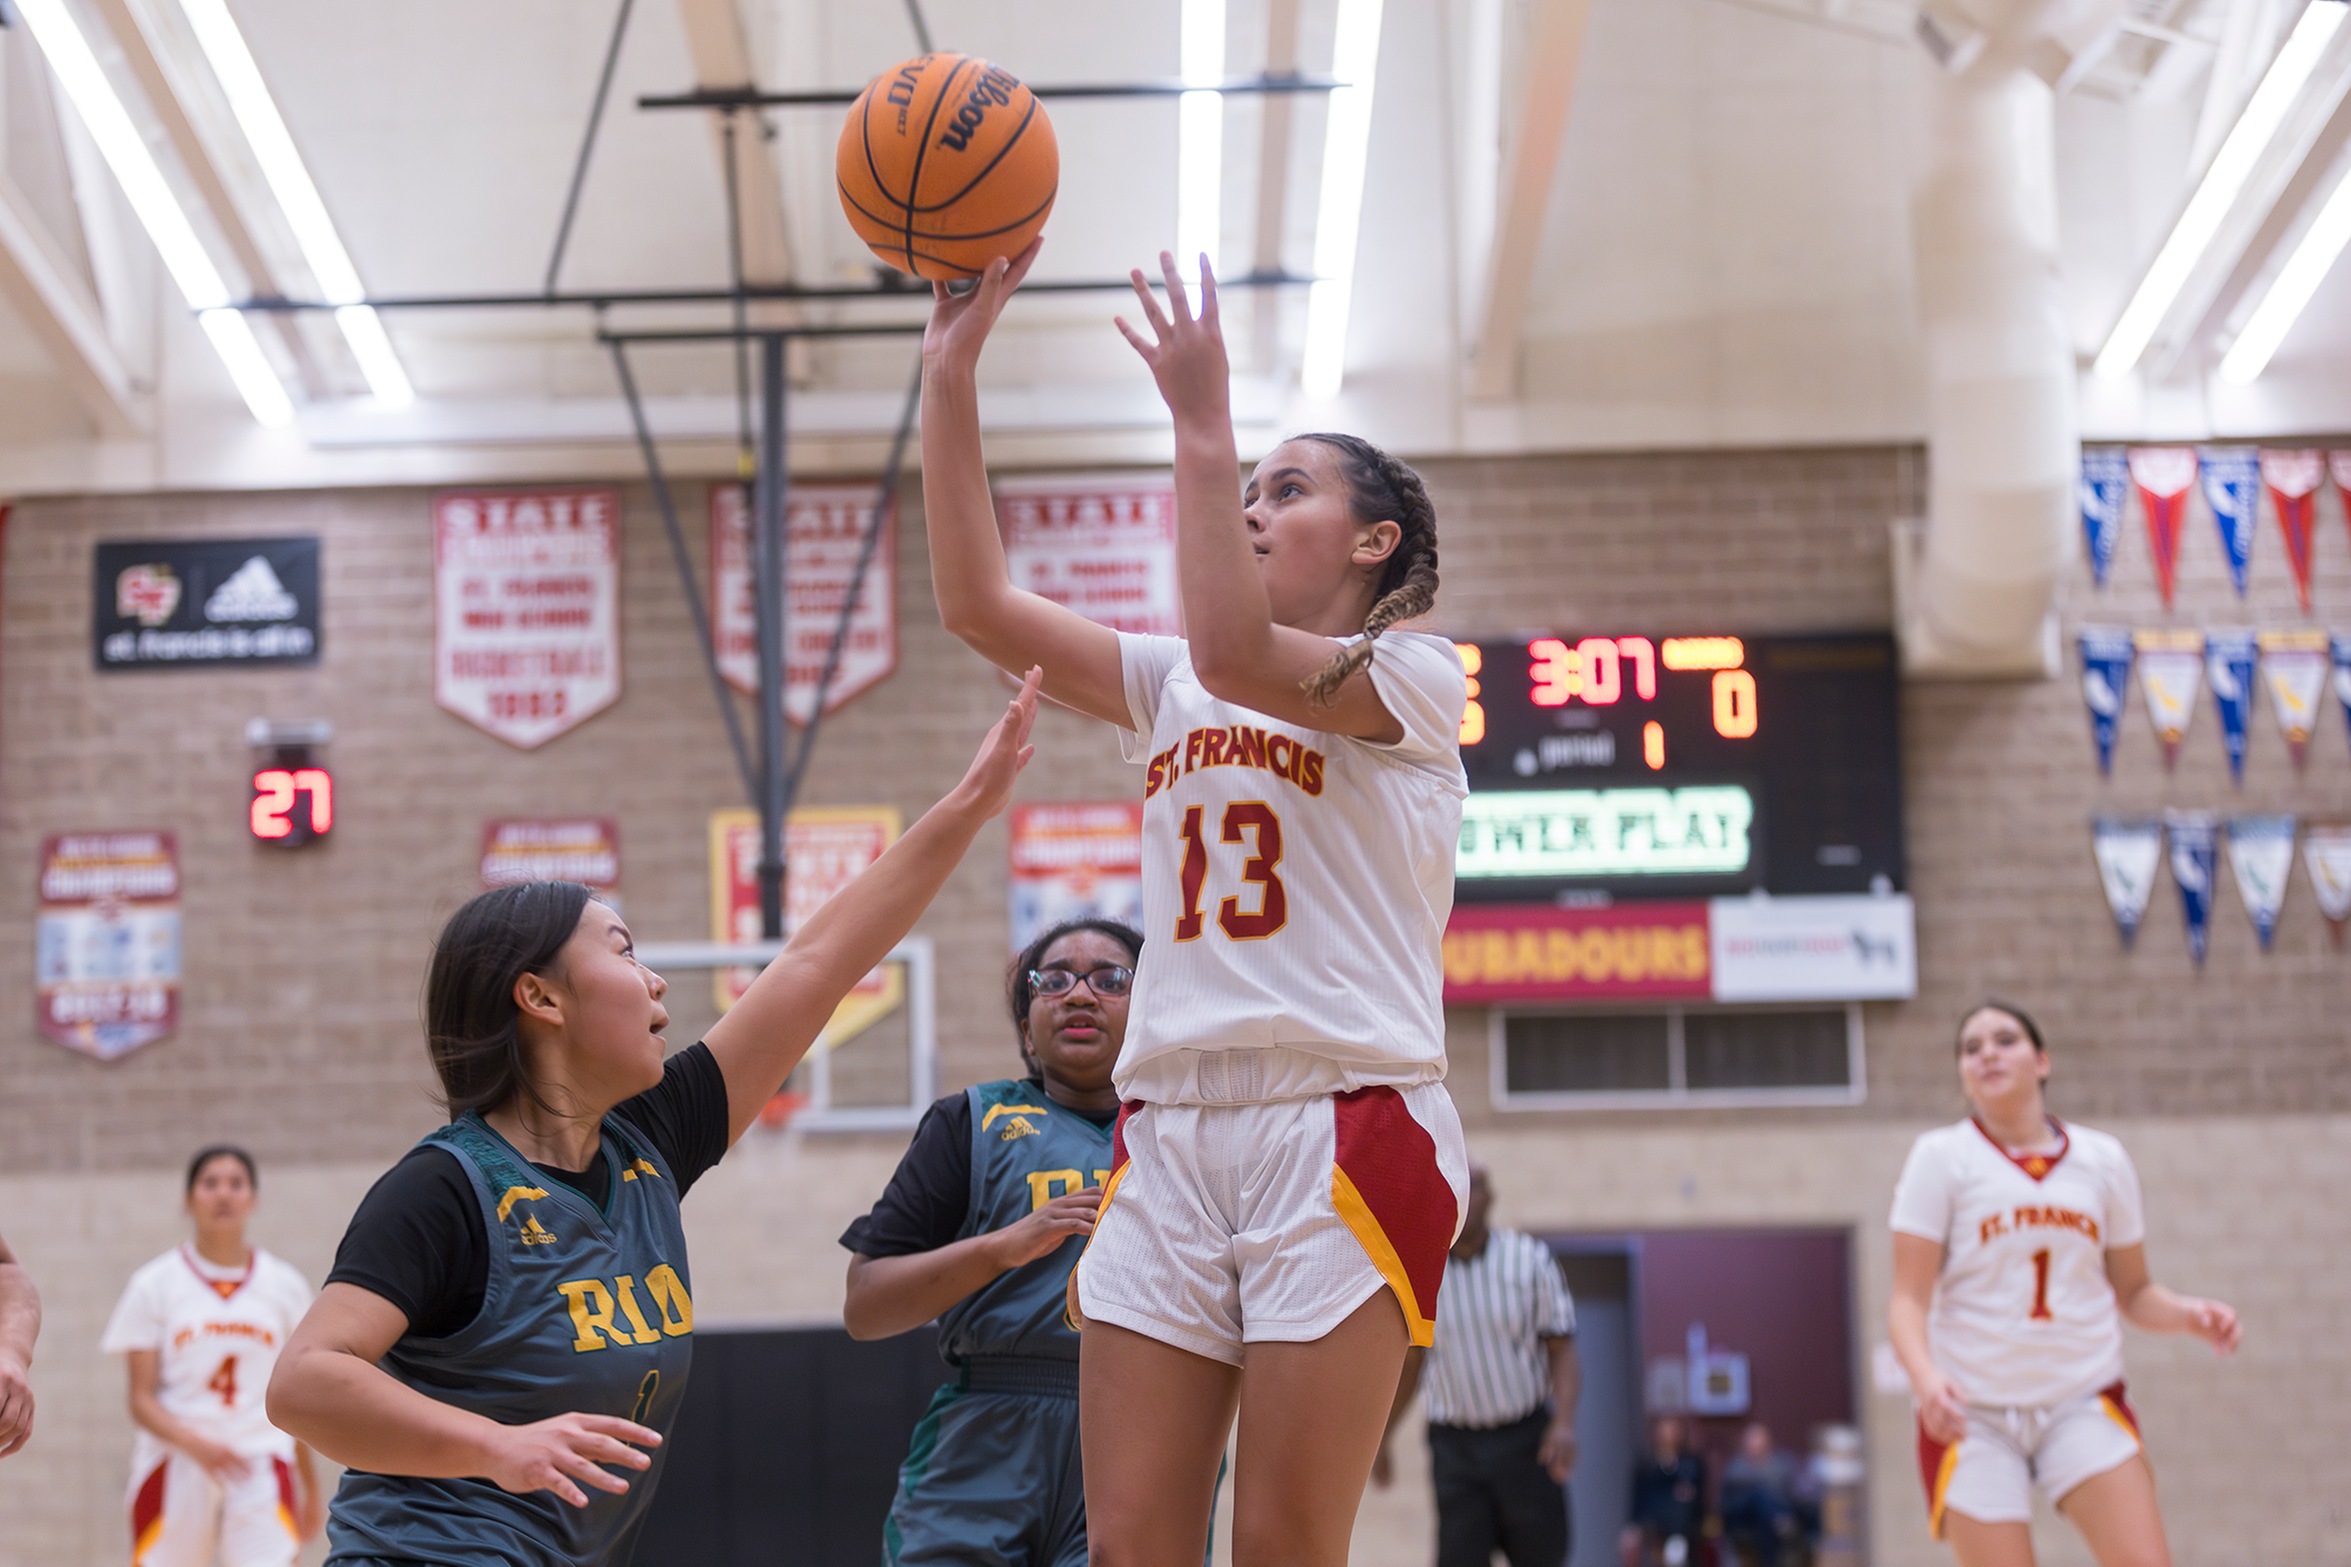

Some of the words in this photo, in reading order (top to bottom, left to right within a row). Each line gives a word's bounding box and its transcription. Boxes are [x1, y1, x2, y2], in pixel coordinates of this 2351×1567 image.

[941, 63, 1020, 152] Wilson
[447, 499, 604, 534] STATE
[1528, 637, 1657, 706] 3:07
[1712, 669, 1758, 738] 0
[1145, 739, 1181, 800] ST.
[1184, 724, 1326, 798] FRANCIS
[1643, 720, 1665, 770] 1
[250, 767, 333, 839] 27
[1601, 785, 1752, 874] PLAY
[1173, 799, 1289, 944] 13
[556, 1262, 694, 1354] RIO
[2029, 1248, 2053, 1321] 1
[206, 1354, 238, 1406] 4
